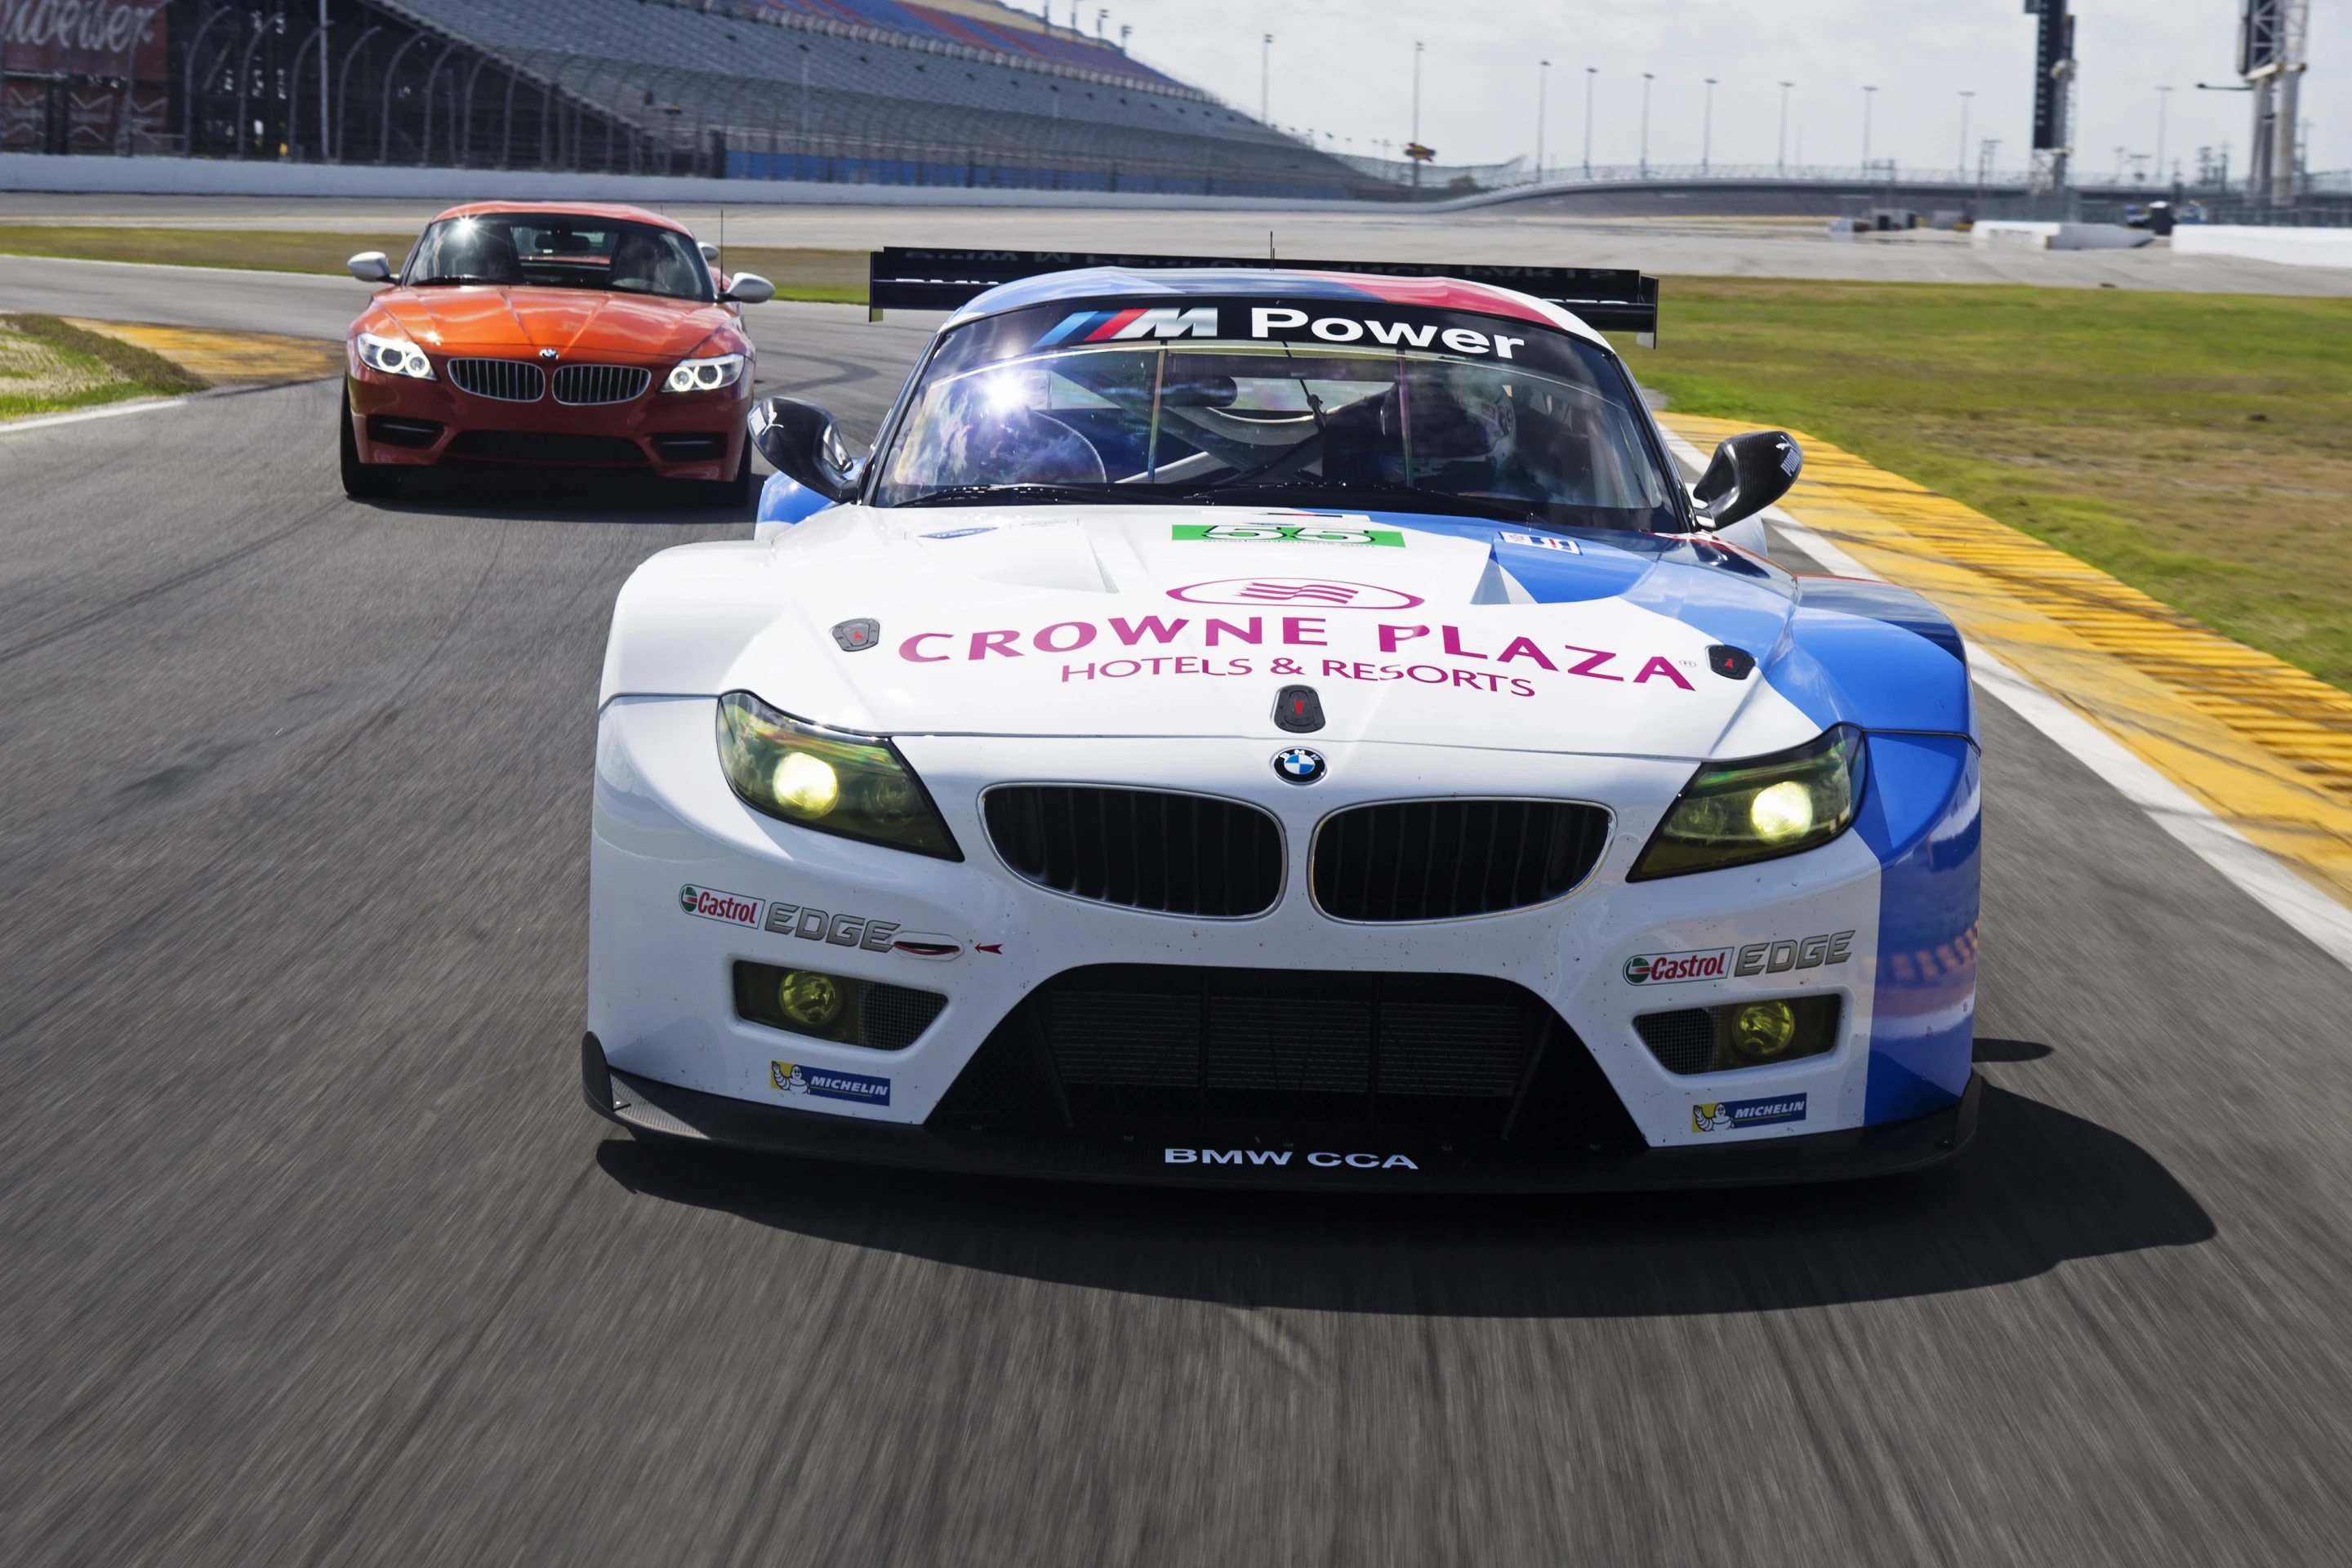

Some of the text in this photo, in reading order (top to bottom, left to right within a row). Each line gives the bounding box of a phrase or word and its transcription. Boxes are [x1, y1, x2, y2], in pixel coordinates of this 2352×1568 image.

[1251, 307, 1526, 359] Power
[1201, 525, 1376, 544] 55
[898, 615, 1696, 692] CROWNE PLAZA
[1062, 656, 1535, 697] HOTELS & RESORTS
[1279, 748, 1321, 761] BMW
[697, 891, 901, 954] Castrol EDGE
[1650, 929, 1856, 981] Castrol EDGE
[810, 1075, 889, 1096] MICHELIN
[1735, 1100, 1806, 1119] MICHELIN
[1165, 1147, 1419, 1170] BMW CCA
